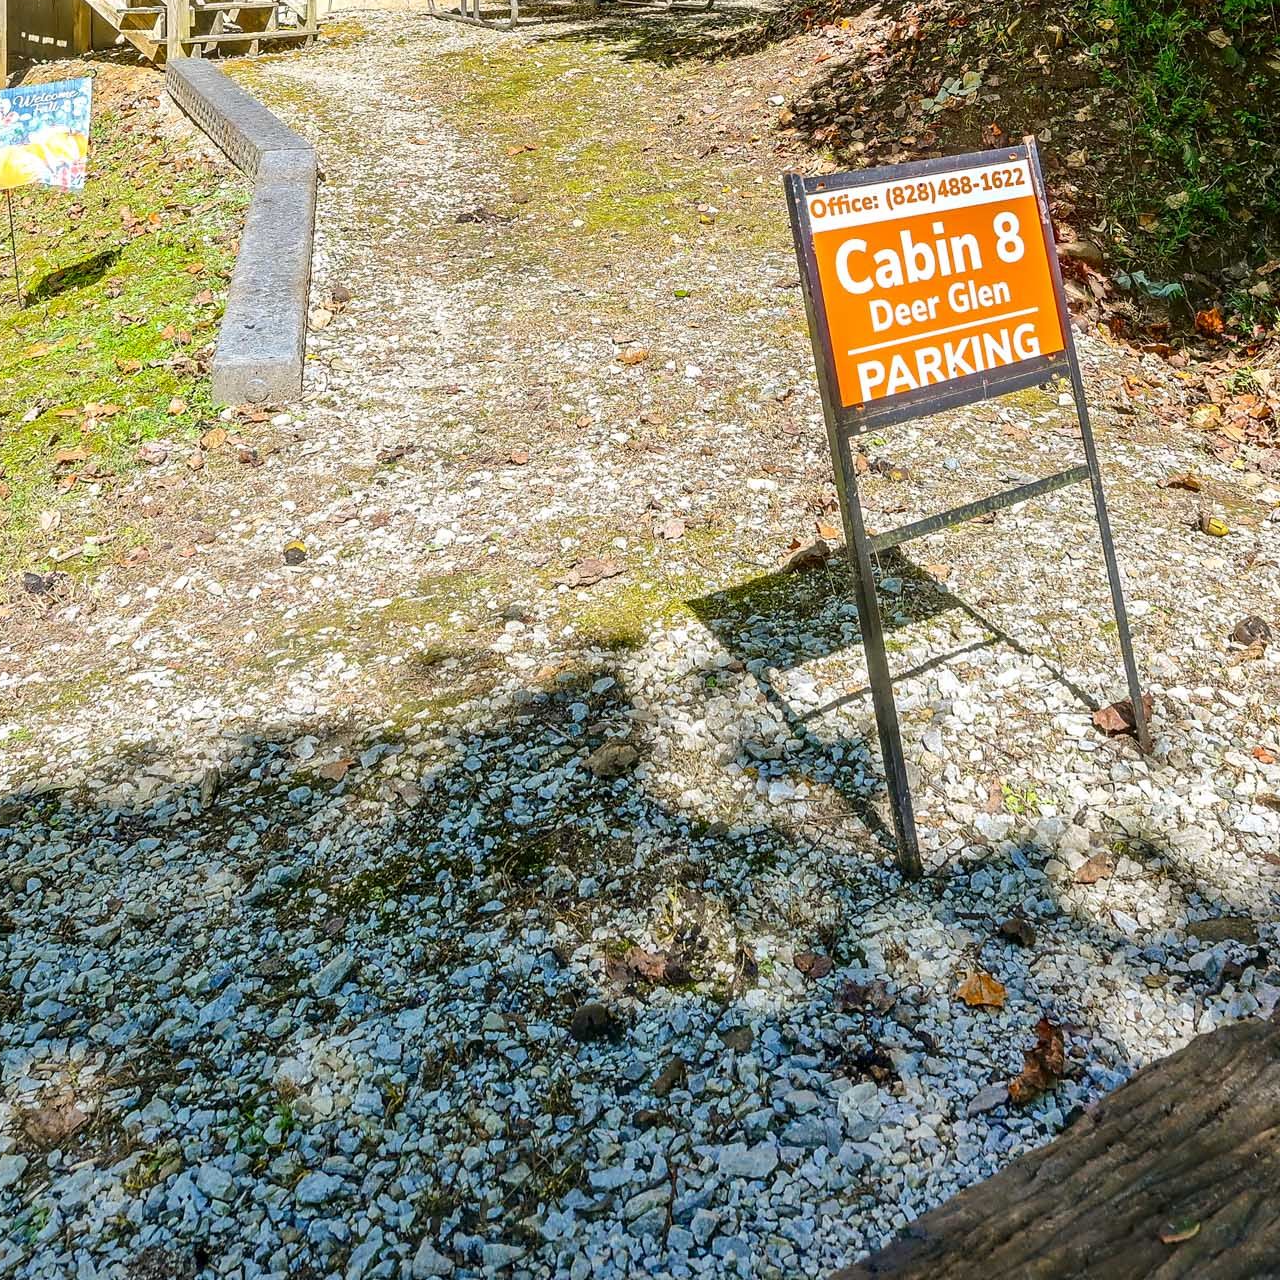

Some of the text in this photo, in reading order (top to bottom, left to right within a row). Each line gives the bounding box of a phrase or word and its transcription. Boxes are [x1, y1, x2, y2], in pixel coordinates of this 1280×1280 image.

[13, 90, 79, 108] Welcome
[810, 167, 1025, 218] Office: (828)488-1622
[835, 212, 1025, 295] Cabin 8
[869, 280, 1011, 332] Deer Glen
[857, 323, 1040, 402] PARKING
